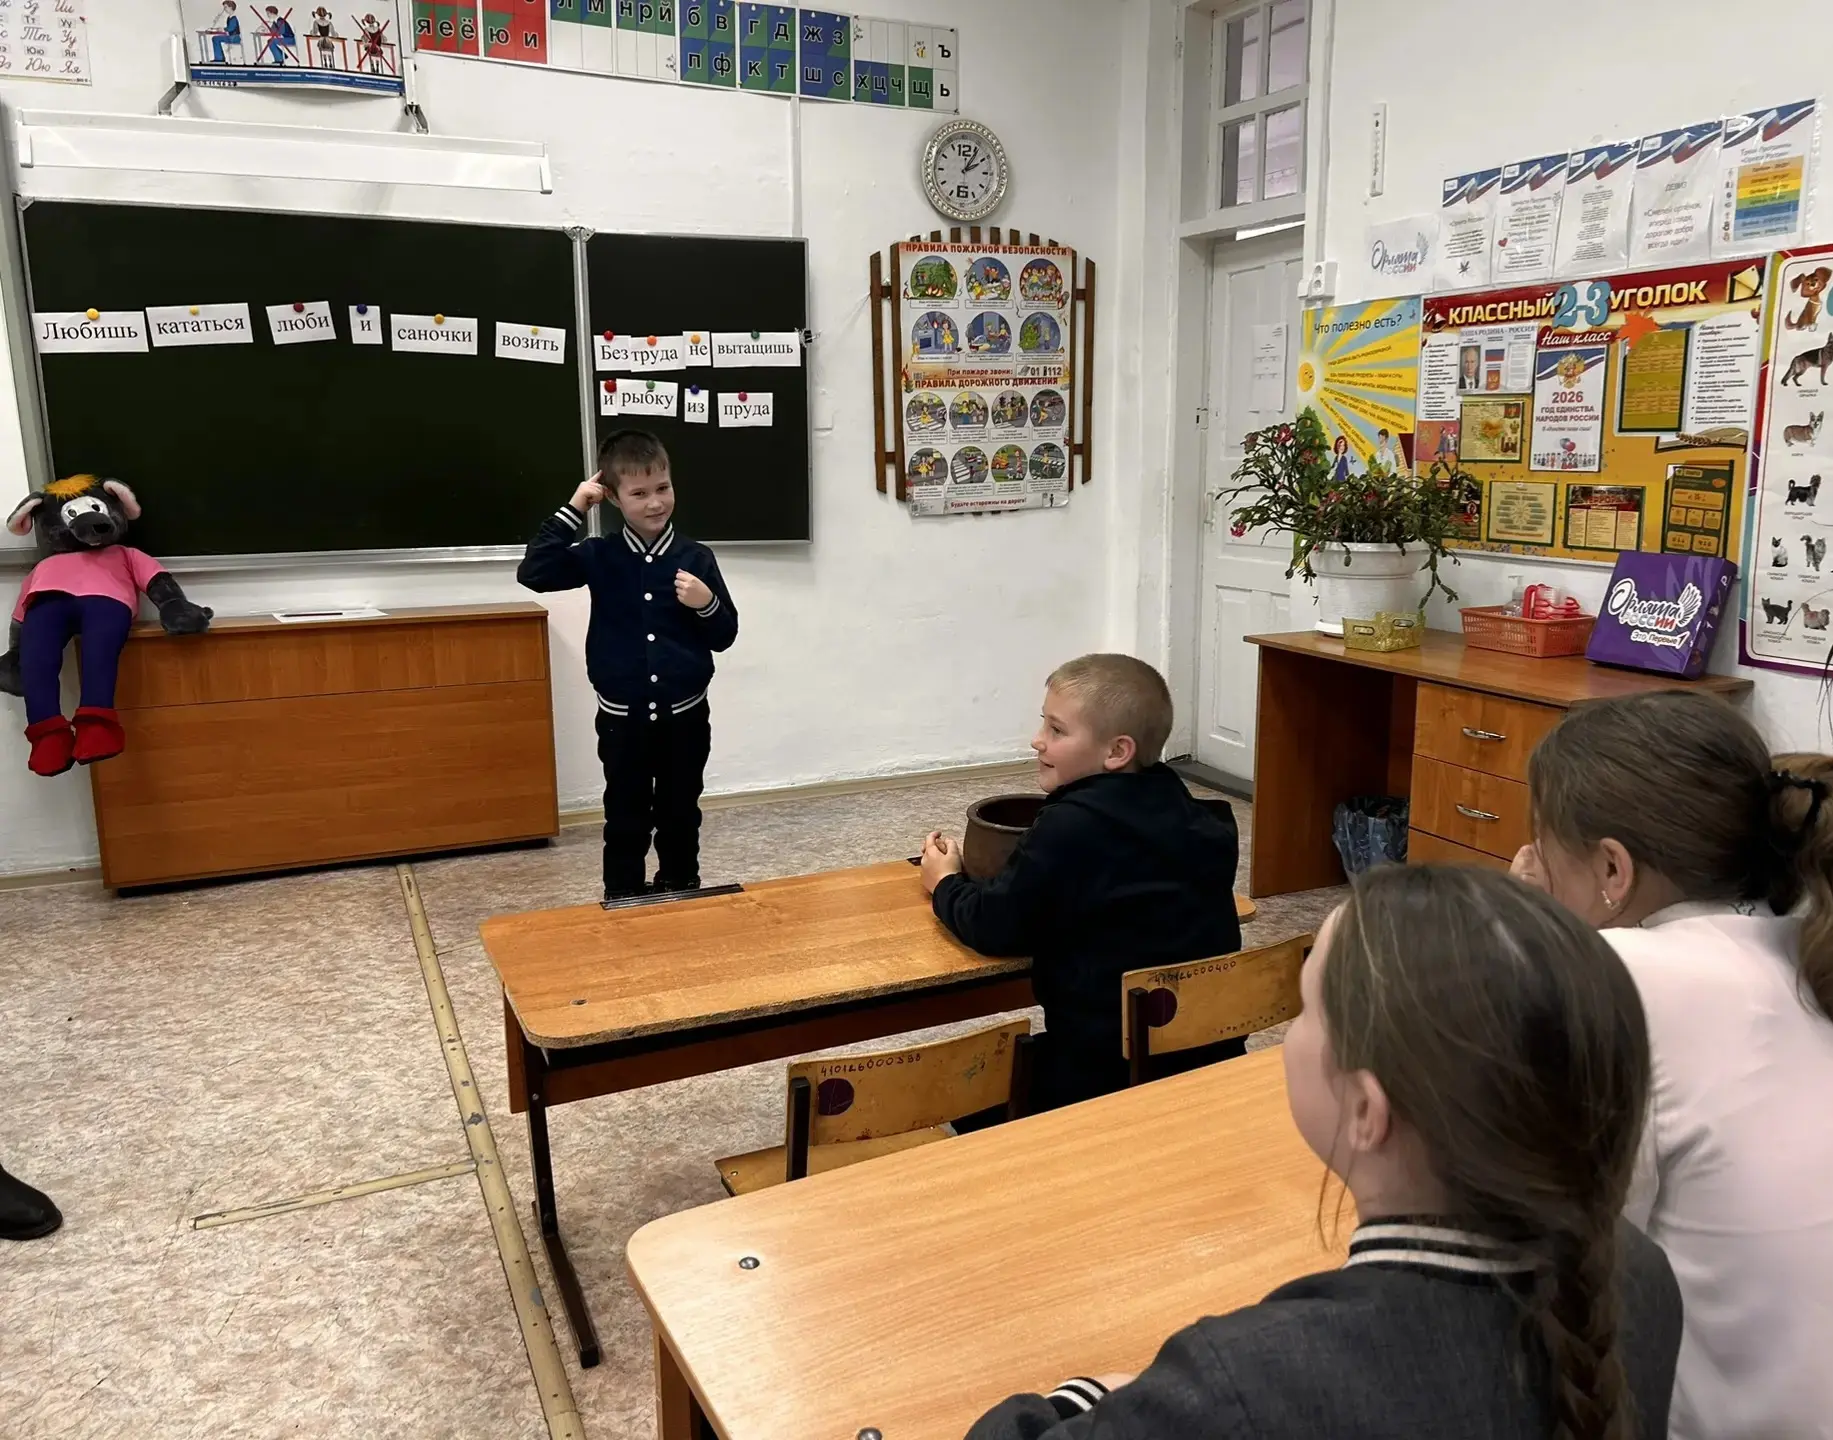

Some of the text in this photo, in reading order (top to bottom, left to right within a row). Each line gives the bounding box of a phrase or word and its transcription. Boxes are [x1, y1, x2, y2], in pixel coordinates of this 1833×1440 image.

[620, 1, 673, 24] н р й
[687, 6, 728, 31] б в
[417, 18, 476, 41] я е ё
[489, 26, 539, 49] ю и
[748, 19, 790, 42] г д
[803, 26, 845, 45] ж з
[688, 53, 732, 77] п ф
[748, 60, 789, 80] к т
[804, 67, 845, 86] ш с
[912, 80, 930, 98] щ
[957, 144, 972, 157] 12
[956, 185, 969, 198] 6
[905, 243, 1068, 256] ПРАВИЛА ПОЖАРНОЙ БЕЗОПАСНОСТИ
[1448, 293, 1556, 326] КЛАССНЫЙ
[1609, 280, 1707, 311] УГОЛОК
[43, 311, 560, 353] Любишь кататься люби и саночки возить
[1314, 314, 1403, 335] Что полезно есть?
[1541, 331, 1612, 345] Наш класс
[601, 343, 794, 365] Без труда не вытащишь
[947, 368, 962, 376] При
[964, 369, 990, 377] пожаре
[1030, 367, 1062, 376] 01 112
[915, 377, 1059, 388] ПРАВИЛА ДОРОЖНОГО ДВИЖЕНИЯ
[604, 389, 771, 419] и рыбку из пруда
[1552, 391, 1584, 404] 2026
[1540, 405, 1595, 414] ГОД ЕДИНСТВА
[1610, 578, 1682, 619] Орлята
[1622, 612, 1676, 630] РОССИИ
[1632, 631, 1647, 640] Это
[1648, 633, 1678, 645] Первые
